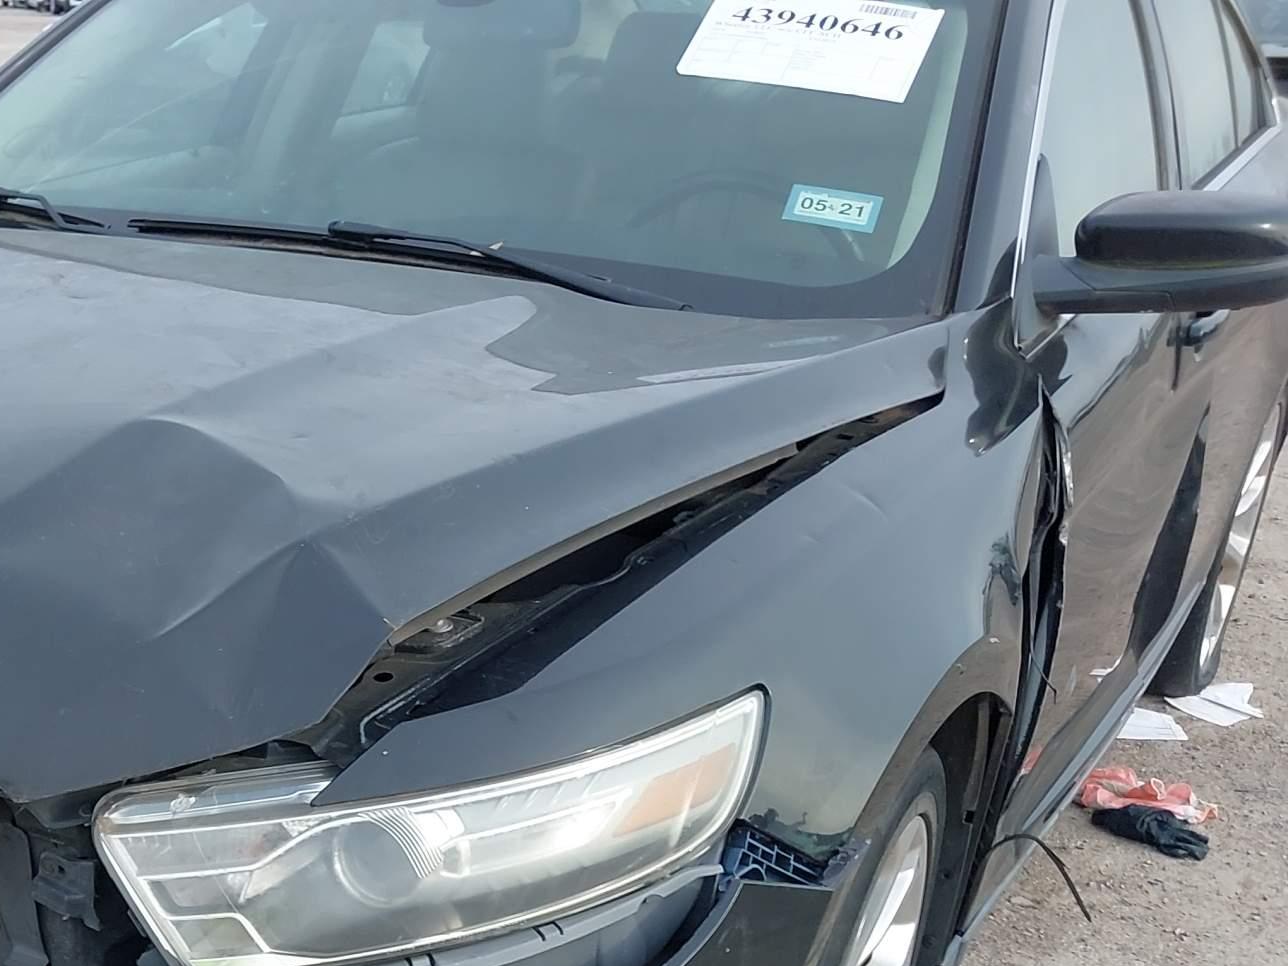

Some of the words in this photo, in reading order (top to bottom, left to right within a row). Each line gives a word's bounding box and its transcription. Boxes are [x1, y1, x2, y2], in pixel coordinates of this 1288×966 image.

[731, 6, 906, 41] 43940646
[800, 196, 828, 212] 05
[838, 202, 865, 217] 21
